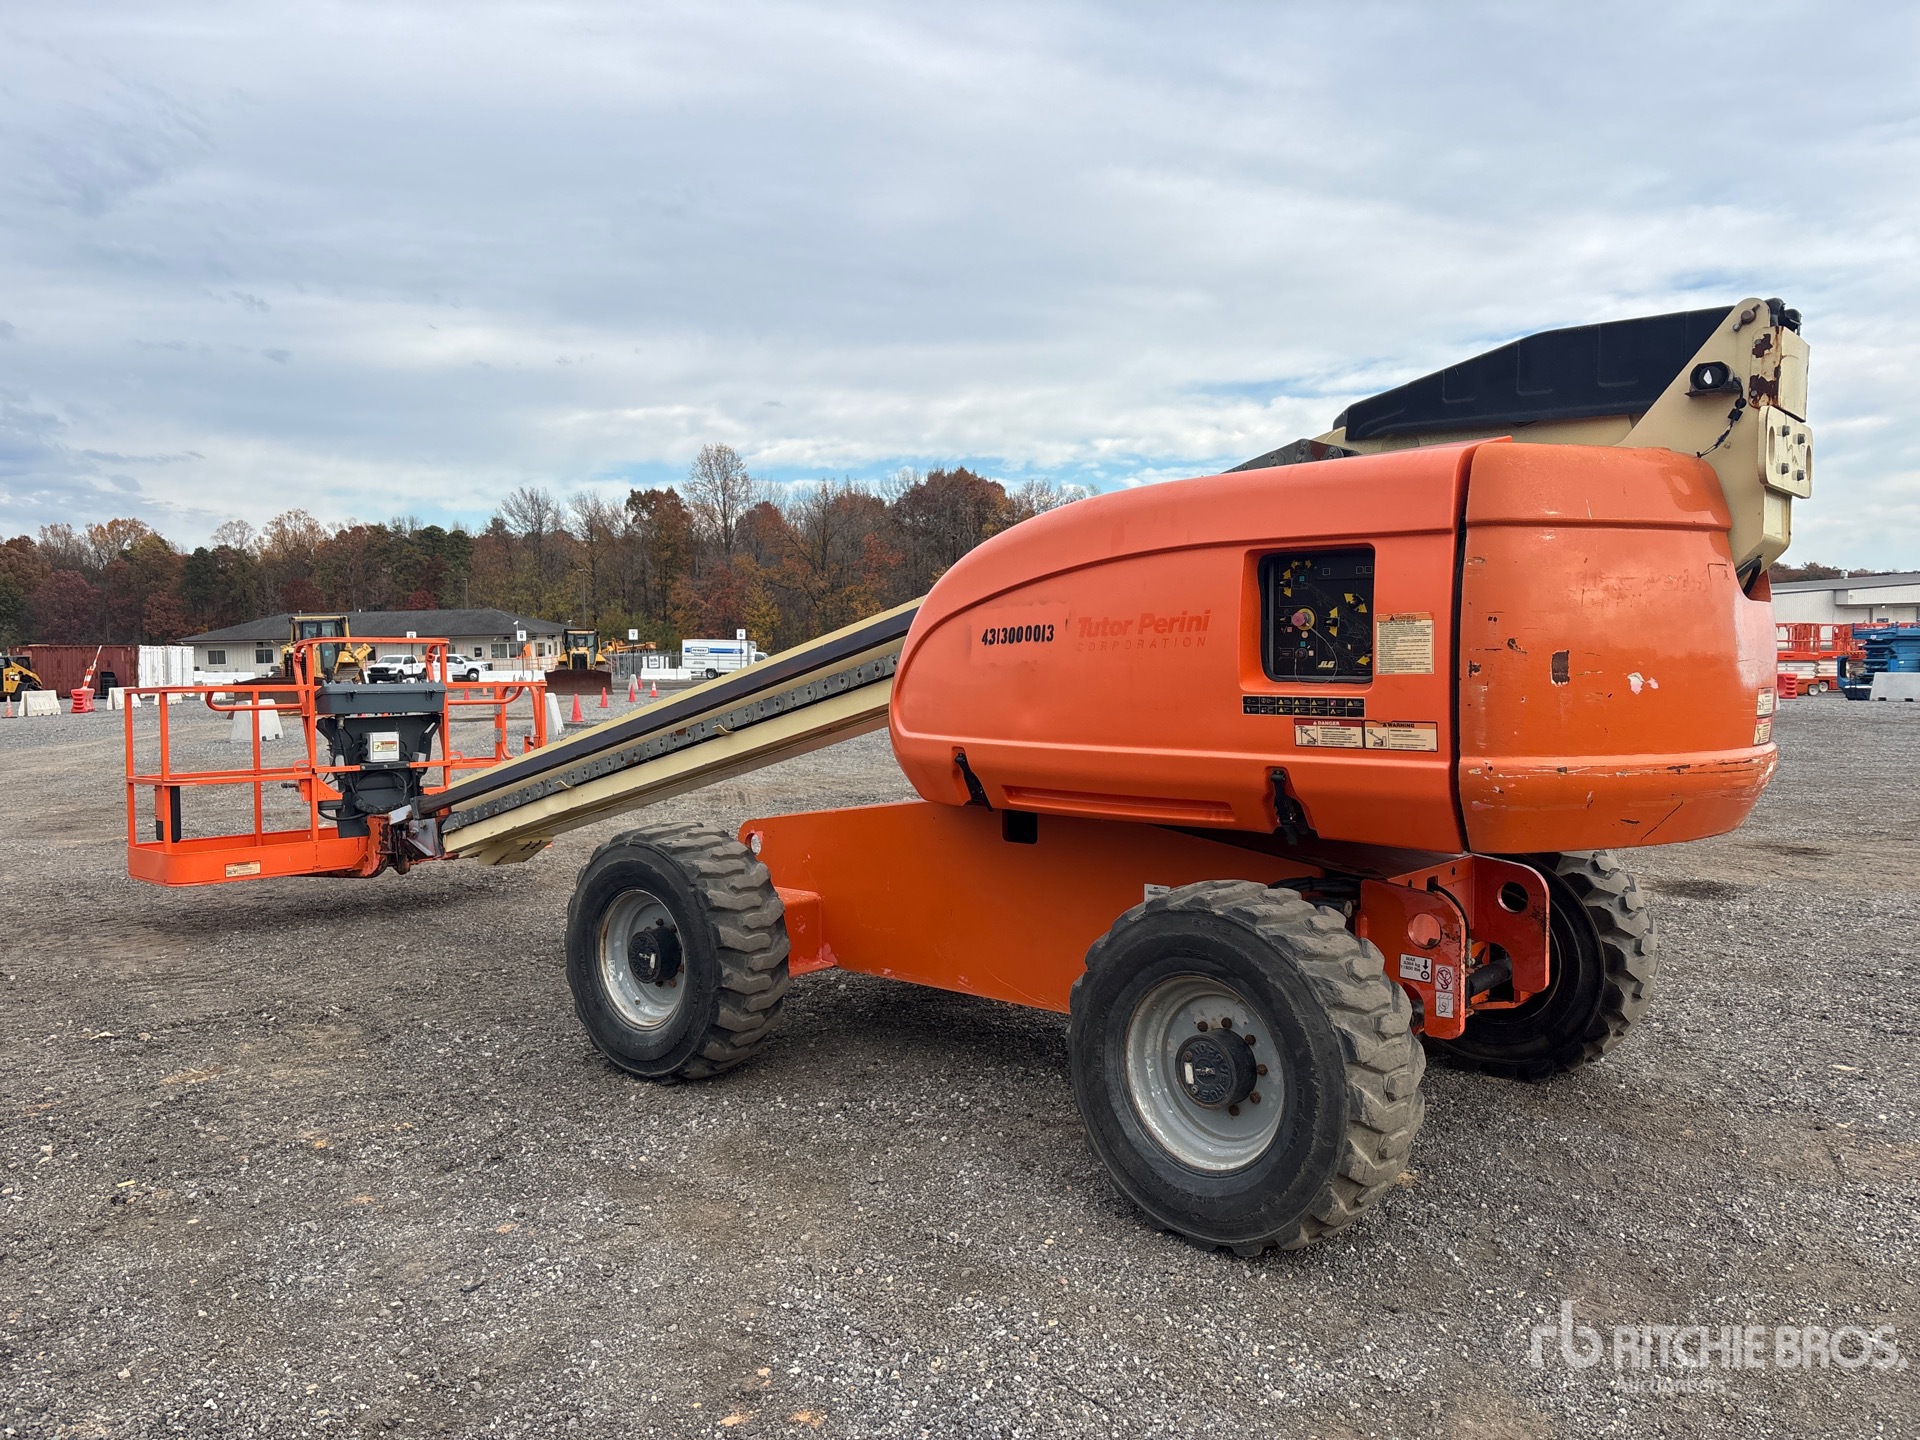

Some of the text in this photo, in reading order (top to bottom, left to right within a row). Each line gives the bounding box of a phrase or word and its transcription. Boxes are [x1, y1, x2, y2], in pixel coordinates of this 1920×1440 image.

[1078, 609, 1211, 638] Tutor Perini
[981, 624, 1055, 646] 4313000013
[1076, 636, 1206, 652] CORPORATION
[1318, 660, 1335, 668] JLG
